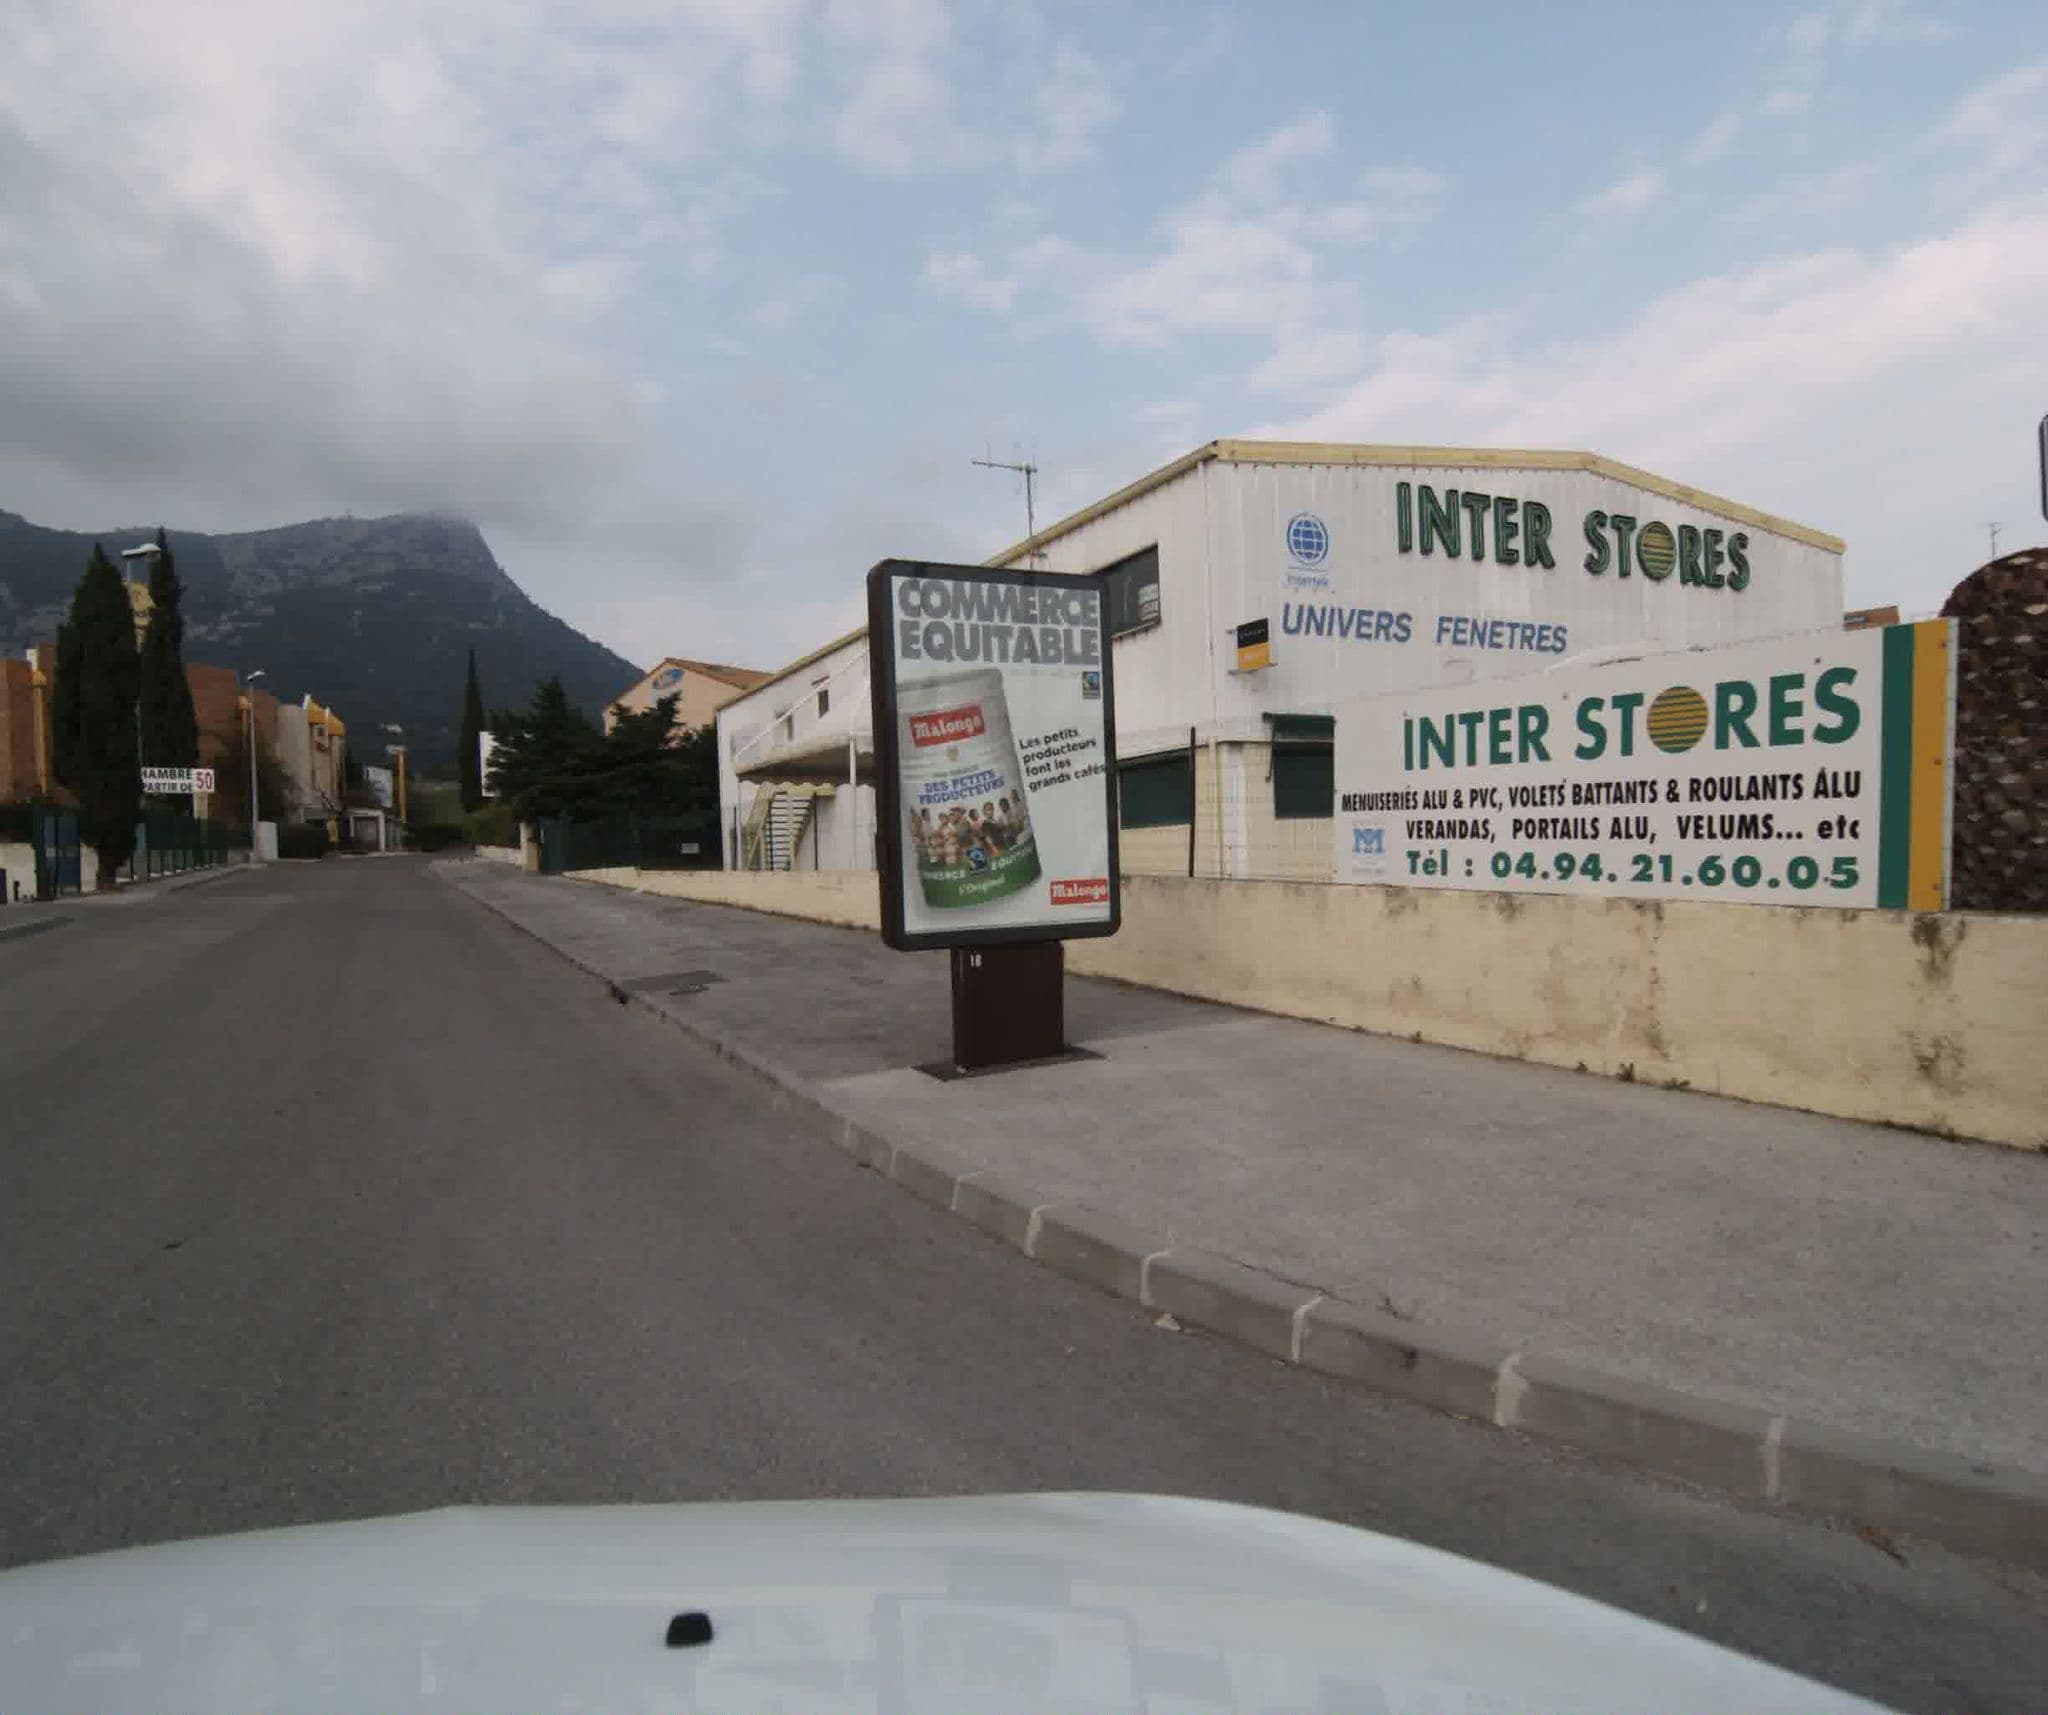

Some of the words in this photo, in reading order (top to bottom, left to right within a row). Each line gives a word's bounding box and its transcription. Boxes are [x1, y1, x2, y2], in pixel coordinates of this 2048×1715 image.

[1396, 481, 1555, 569] INTER
[1584, 509, 1751, 591] STORES
[899, 578, 1098, 626] COMMERCE
[1282, 602, 1412, 643] UNIVERS
[1436, 615, 1567, 653] FENETRES
[900, 619, 1099, 666] EQUITABLE
[913, 714, 982, 739] Malongo
[1403, 704, 1551, 771] INTER
[1575, 667, 1861, 760] STORES
[1019, 737, 1041, 750] Les
[1044, 729, 1079, 745] petits
[1023, 739, 1097, 765] producteurs
[196, 771, 213, 789] 50
[1026, 762, 1052, 777] font
[1054, 759, 1072, 770] les
[1029, 773, 1071, 792] grands
[1342, 790, 1418, 812] MENUISERIES
[1423, 789, 1448, 810] ALU
[1453, 789, 1464, 808] &
[1469, 786, 1503, 811] PVC,
[1509, 784, 1565, 807] VOLETS
[1572, 780, 1657, 805] BATTANTS
[1666, 779, 1680, 803] &
[1689, 774, 1804, 802] ROULANTS
[1813, 769, 1861, 799] ALU
[1406, 818, 1496, 843] VERANDAS,
[1512, 817, 1599, 839] PORTAILS
[1609, 816, 1656, 844] ALU,
[1677, 814, 1803, 840] VELUMS...
[1817, 815, 1860, 839] etc
[1052, 882, 1107, 900] Malongo
